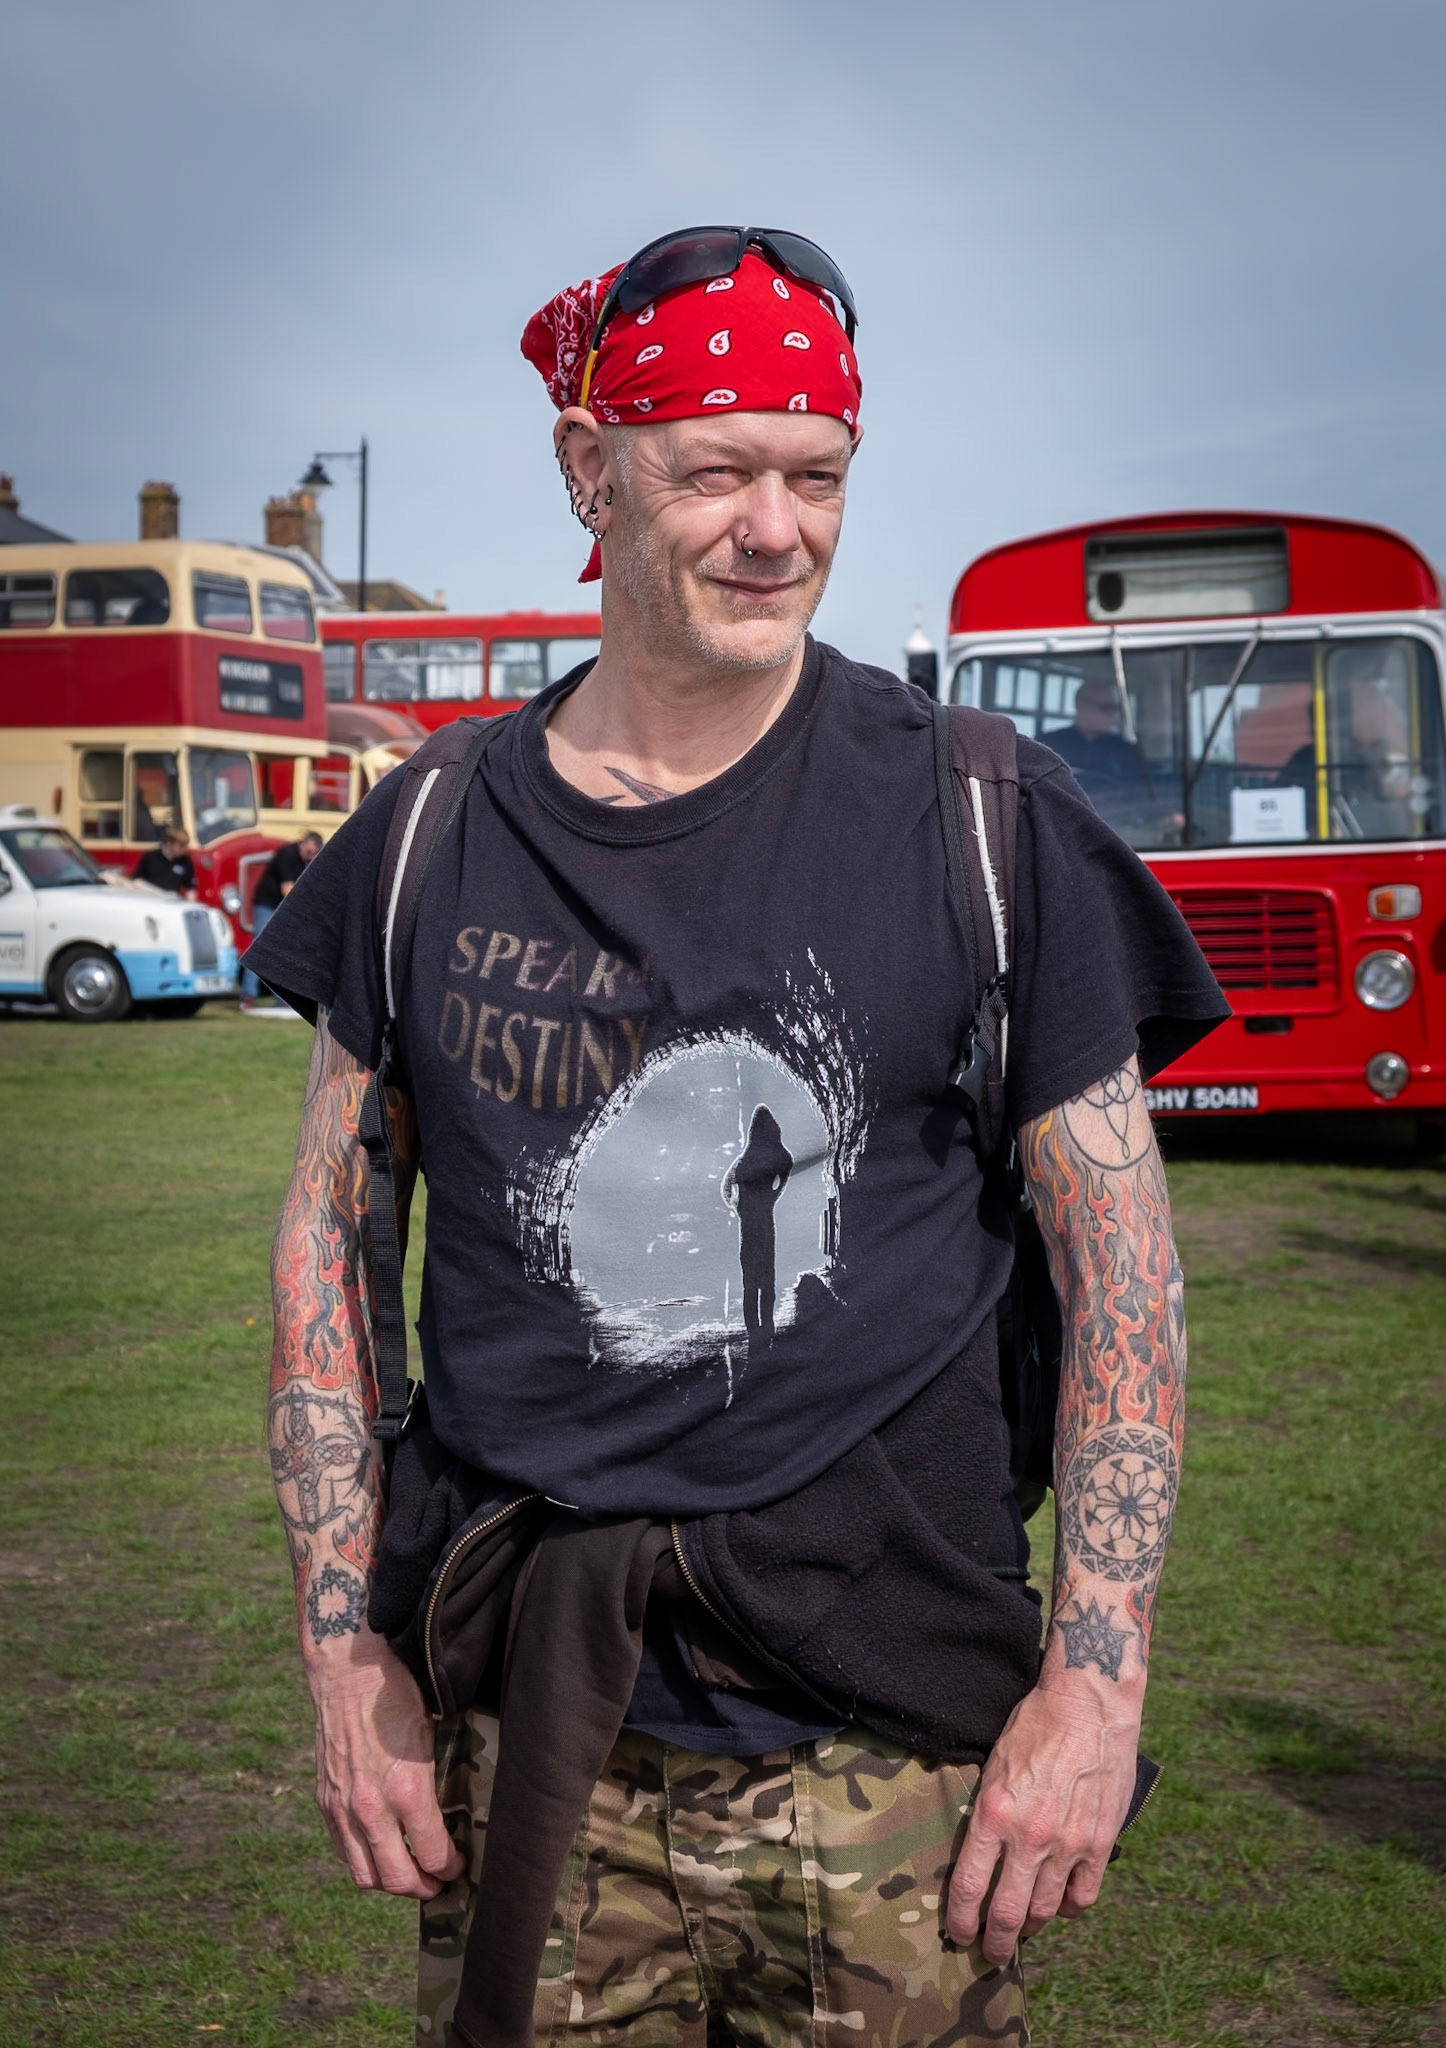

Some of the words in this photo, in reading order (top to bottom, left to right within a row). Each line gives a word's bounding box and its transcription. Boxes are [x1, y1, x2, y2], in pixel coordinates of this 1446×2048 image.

[449, 926, 623, 999] SPEAR
[437, 991, 649, 1109] DESTINY
[1192, 1086, 1258, 1108] 504N
